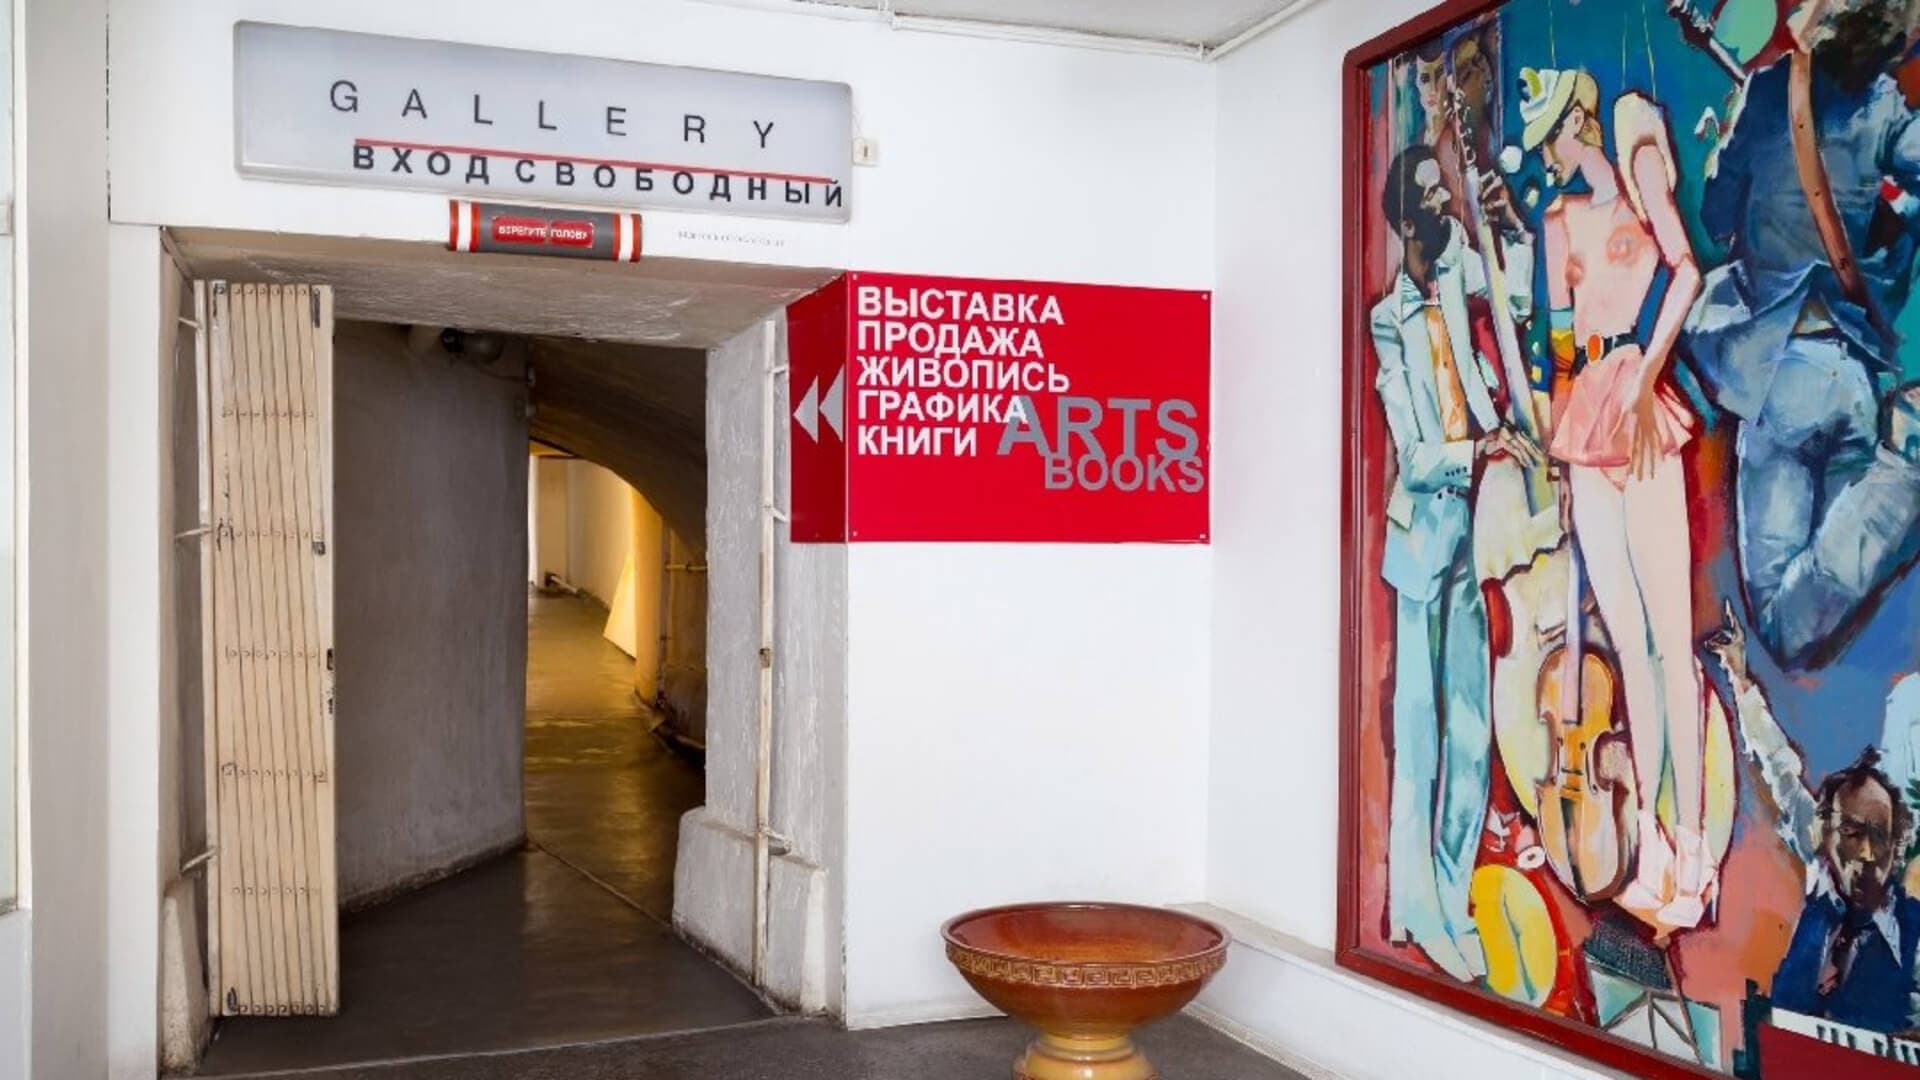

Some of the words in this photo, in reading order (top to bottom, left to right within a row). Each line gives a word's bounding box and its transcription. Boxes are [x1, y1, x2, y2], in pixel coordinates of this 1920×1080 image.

[329, 81, 775, 149] GALLERY
[352, 146, 489, 184] ВХОД
[515, 160, 844, 208] СВОБОДНЫЙ
[857, 286, 1064, 325] ВЫСТАВКА
[857, 322, 1044, 358] ПРОДАЖА
[856, 357, 1070, 393] ЖИВОПИСЬ
[857, 390, 1029, 424] ГРАФИКА
[857, 426, 978, 456] КНИГИ
[997, 396, 1200, 460] ARTS
[1044, 455, 1205, 493] BOOKS
